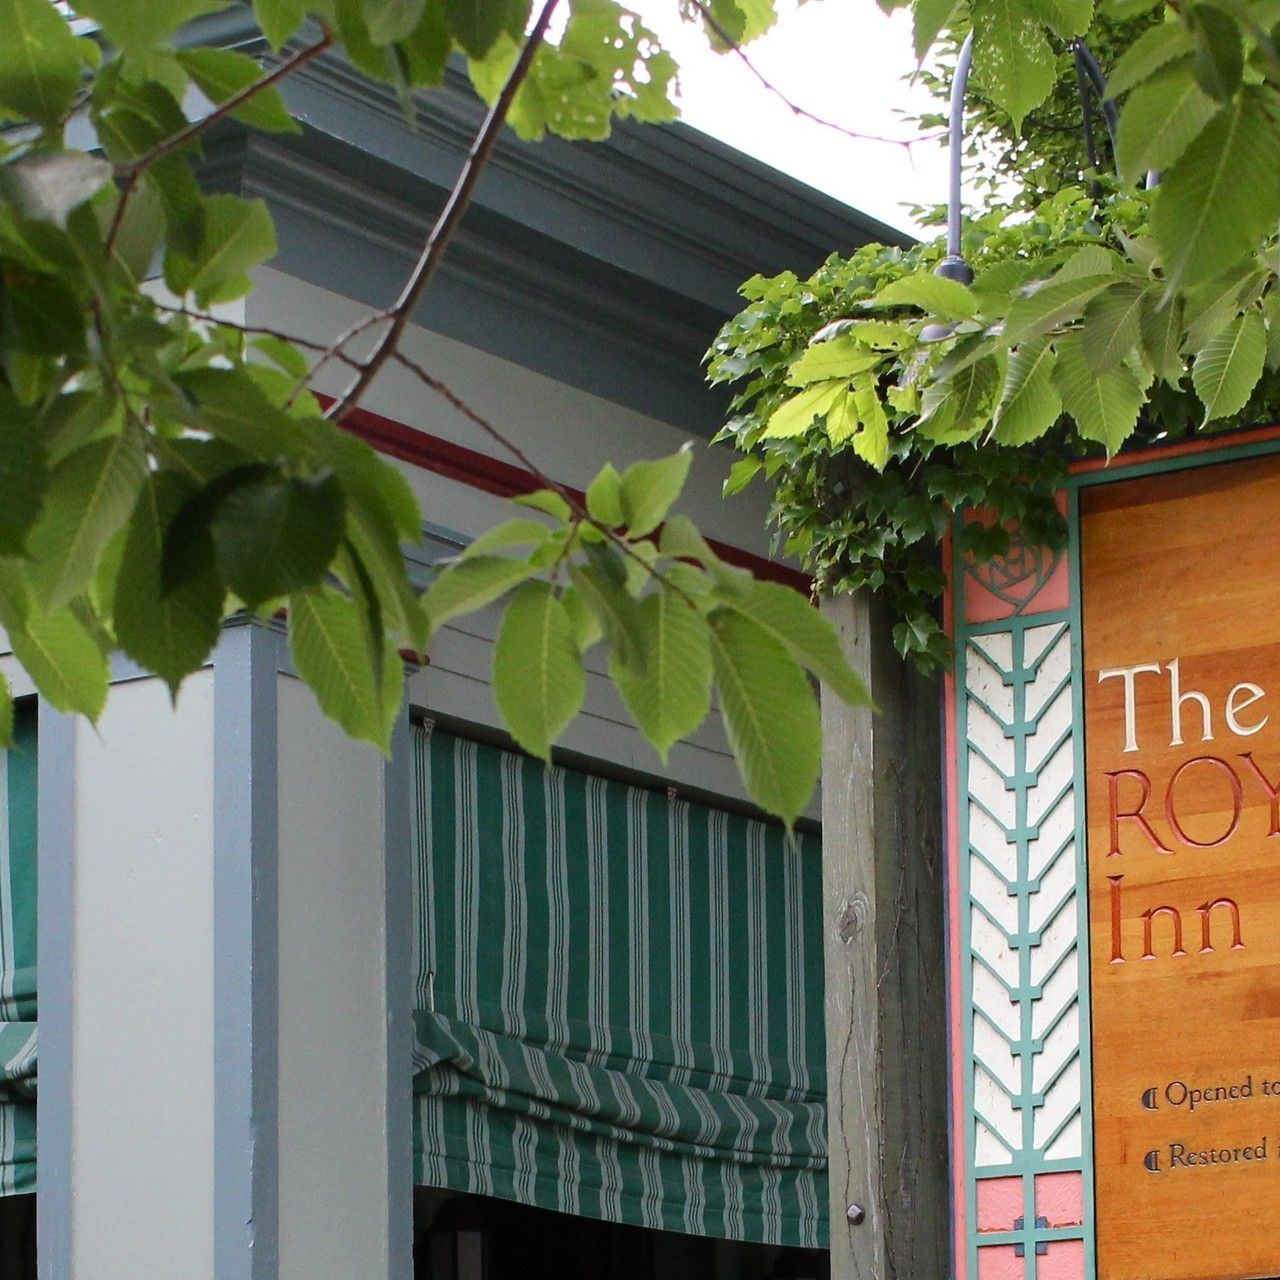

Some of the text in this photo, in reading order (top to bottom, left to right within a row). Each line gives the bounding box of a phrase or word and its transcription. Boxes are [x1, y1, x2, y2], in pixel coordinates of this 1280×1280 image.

[1097, 657, 1269, 753] The
[1106, 874, 1247, 964] Inn
[1164, 1075, 1254, 1112] Opened
[1168, 1136, 1268, 1170] Restored
